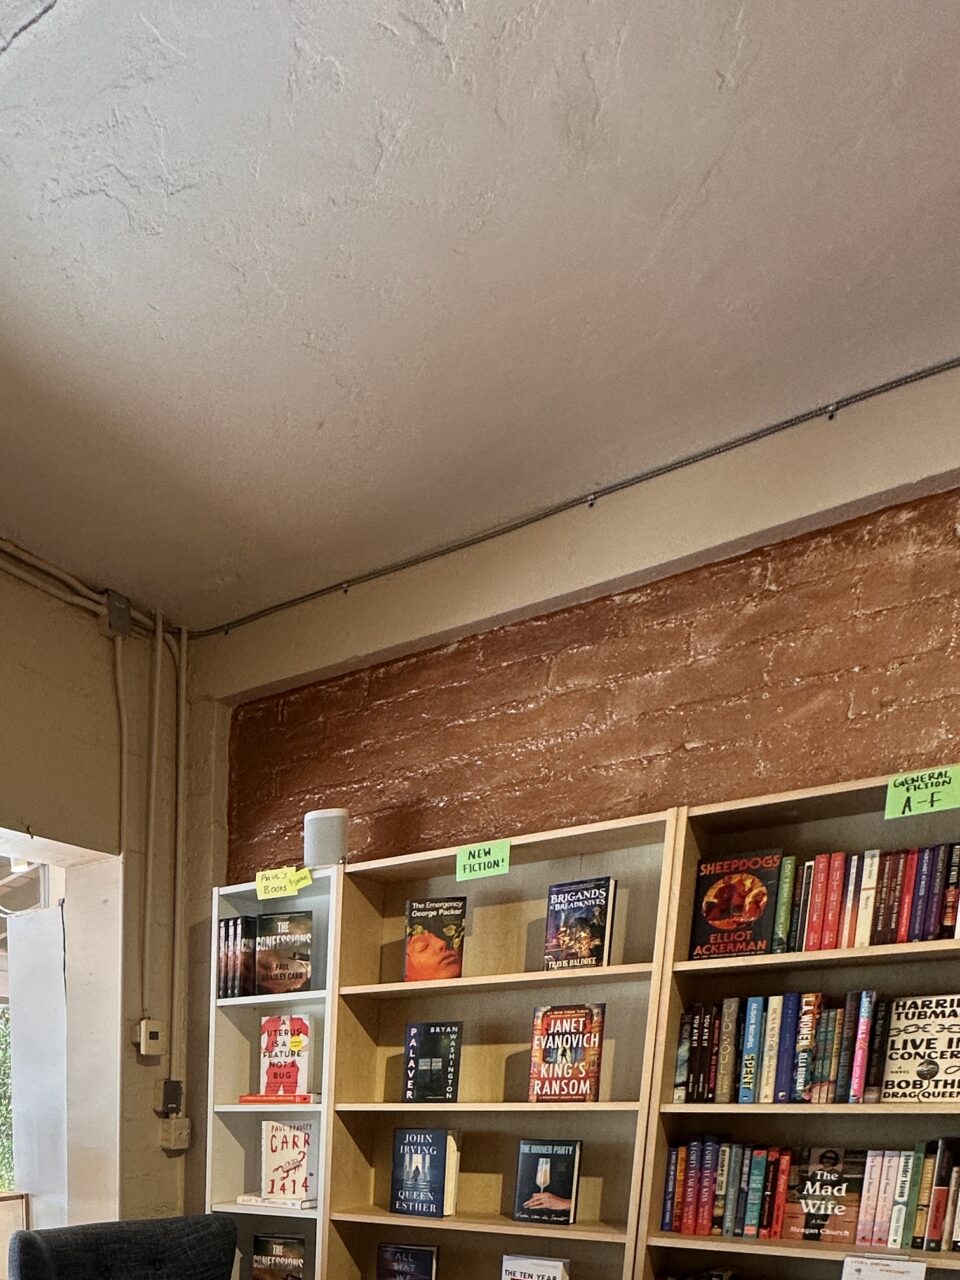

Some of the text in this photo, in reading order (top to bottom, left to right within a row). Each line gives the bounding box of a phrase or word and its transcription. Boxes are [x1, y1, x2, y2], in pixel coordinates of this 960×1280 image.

[893, 770, 951, 788] GENERAL
[905, 778, 953, 793] FICTION
[467, 848, 491, 860] NEW
[463, 858, 505, 874] FICTION!
[700, 854, 782, 876] SHEEPDOGS
[550, 888, 607, 904] BRIGANDS
[425, 900, 463, 910] Emergency
[411, 907, 463, 918] George Packer
[277, 921, 290, 932] THE
[256, 934, 312, 951] CONFESSIONS
[709, 930, 752, 943] ELLIOT
[693, 940, 767, 956] ACKERMAN
[548, 1018, 585, 1034] JANET
[267, 1028, 302, 1038] UTERUS
[534, 1033, 599, 1050] EVANOVICH
[889, 1038, 938, 1051] LIVE
[262, 1049, 302, 1059] FEATURE
[406, 1028, 418, 1099] PALAVER
[540, 1062, 587, 1078] KING'S
[273, 1071, 292, 1080] BUG
[742, 1054, 756, 1090] SPENT
[533, 1079, 590, 1096] RANSOM
[884, 1080, 924, 1090] BOB
[882, 1091, 918, 1099] DRAG
[270, 1133, 311, 1154] CARR
[403, 1133, 433, 1143] JOHN
[399, 1144, 437, 1155] IRVING
[815, 1170, 839, 1181] The
[266, 1176, 310, 1195] 1414
[802, 1181, 849, 1197] Mad
[398, 1190, 435, 1201] QUEEN
[395, 1200, 437, 1213] ESTHER
[800, 1199, 847, 1216] Wife
[790, 1226, 850, 1237] Meagan Church
[272, 1244, 284, 1255] THE
[252, 1254, 304, 1269] CONFESSIONS
[394, 1252, 414, 1261] ALL
[504, 1269, 517, 1278] THE
[519, 1271, 534, 1280] TEN
